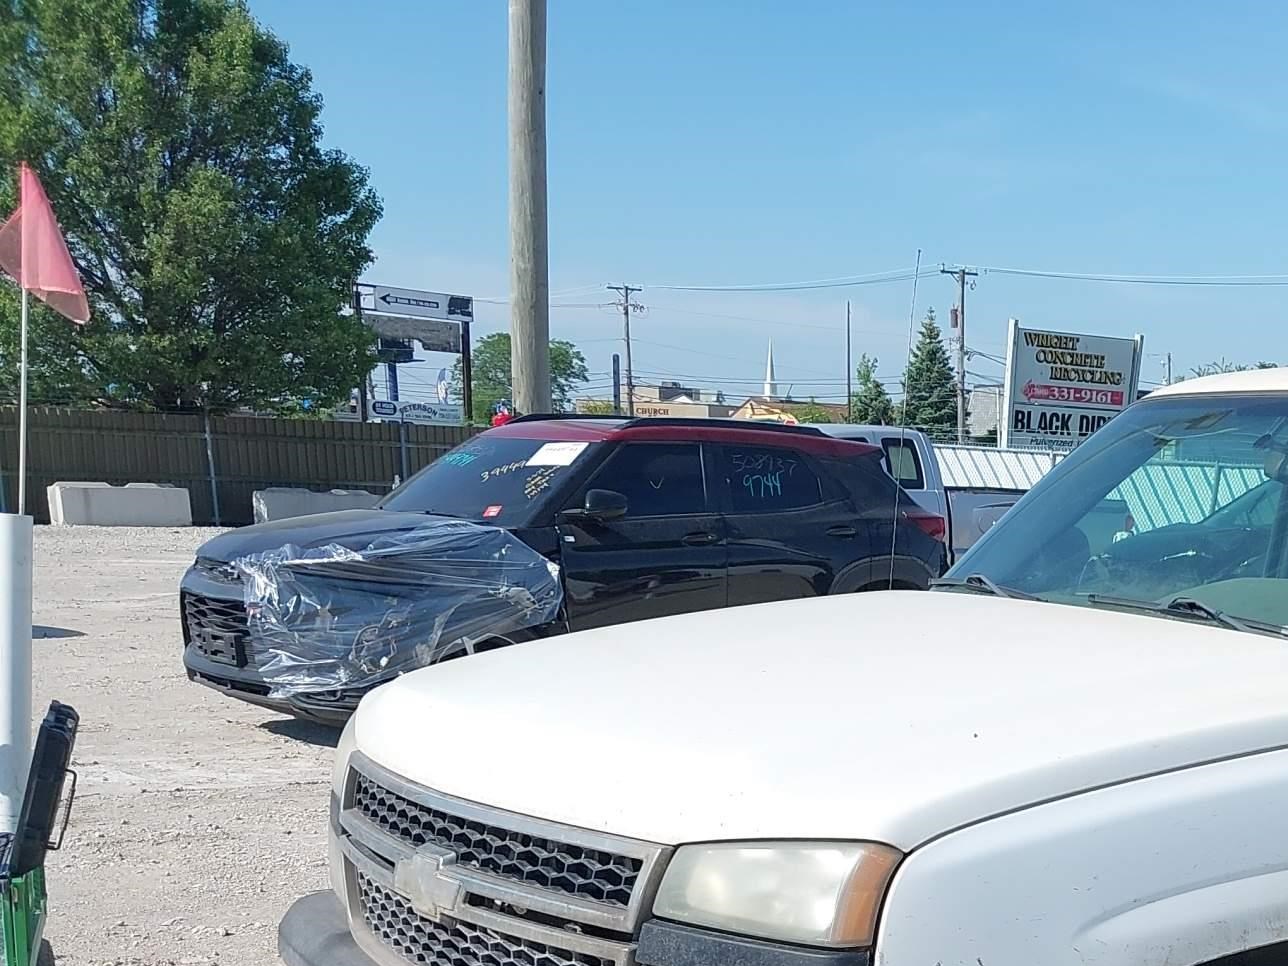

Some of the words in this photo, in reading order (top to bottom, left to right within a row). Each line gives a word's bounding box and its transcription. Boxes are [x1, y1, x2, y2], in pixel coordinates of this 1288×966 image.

[1023, 331, 1080, 351] WRIGHT
[1035, 349, 1106, 369] CONCRETE
[1049, 366, 1123, 386] RECYCLING
[1049, 387, 1113, 404] 331-9161
[635, 407, 670, 416] CHURCH
[1013, 409, 1073, 437] BLACK
[1078, 414, 1112, 437] DIR
[743, 472, 781, 497] 9744
